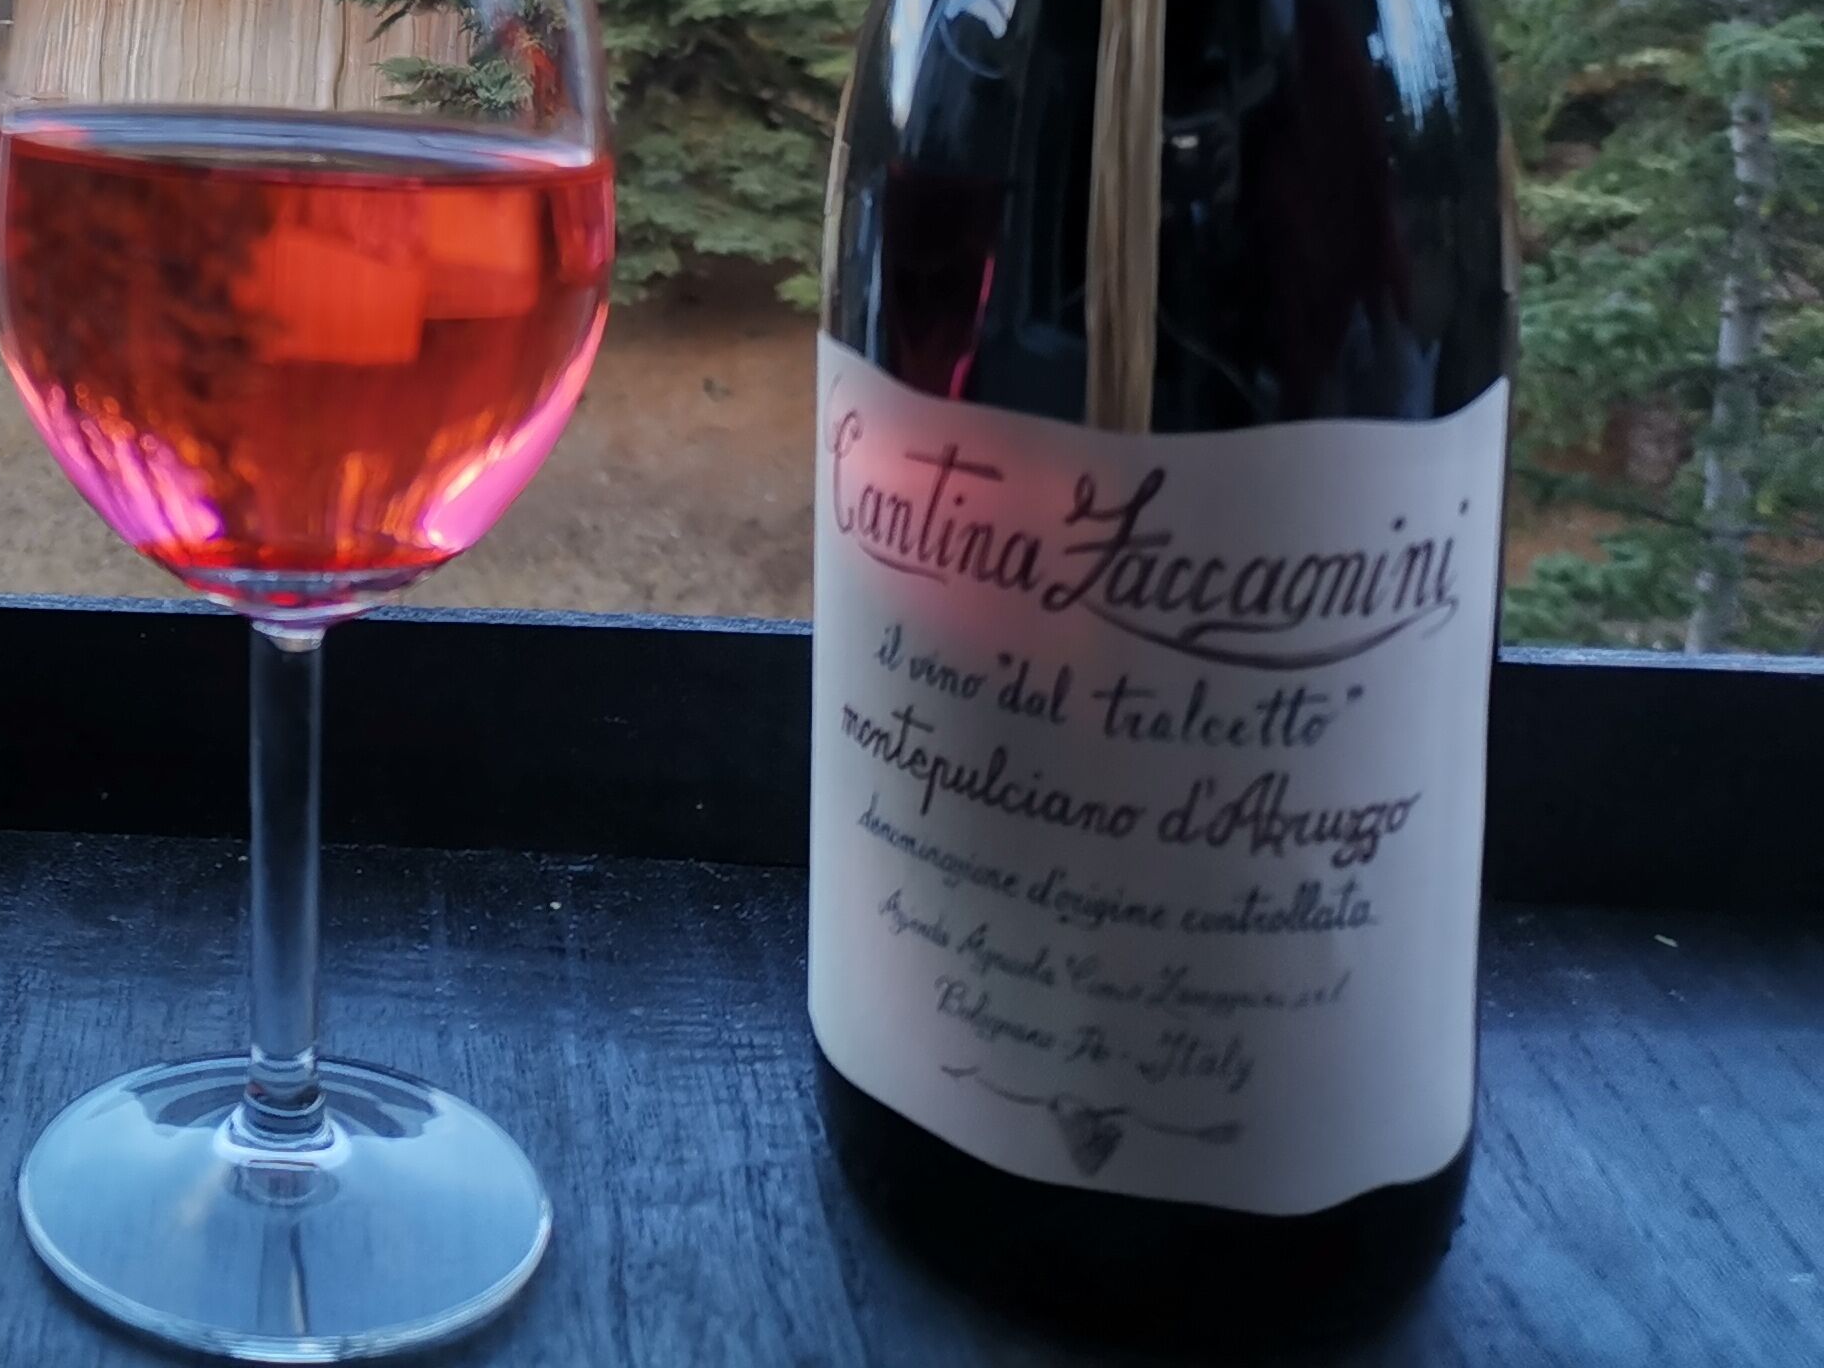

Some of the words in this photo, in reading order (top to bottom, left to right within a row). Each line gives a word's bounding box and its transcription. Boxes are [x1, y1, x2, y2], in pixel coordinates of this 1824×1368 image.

[824, 407, 1042, 594] Cantina
[1045, 466, 1469, 670] Zaccagnini
[908, 650, 986, 701] vino
[840, 702, 1149, 839] montepulciano
